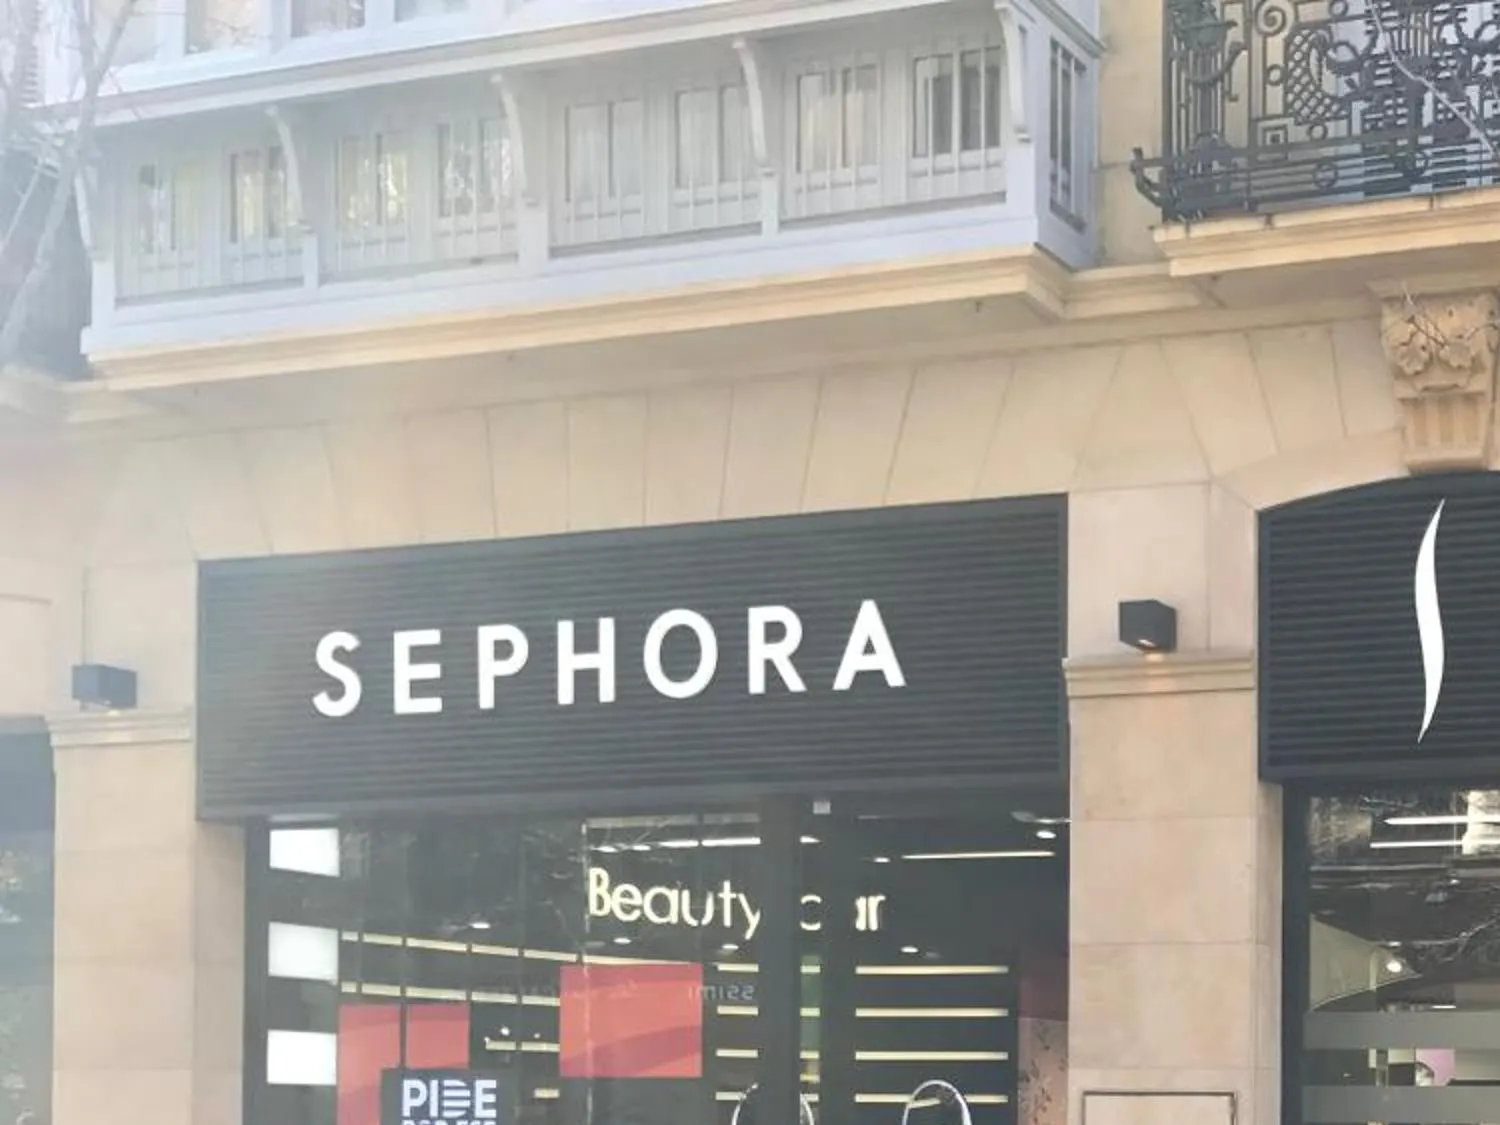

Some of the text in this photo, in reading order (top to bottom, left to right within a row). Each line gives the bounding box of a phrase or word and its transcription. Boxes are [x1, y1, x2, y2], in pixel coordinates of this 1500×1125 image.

[313, 600, 906, 717] SEPHORA
[588, 867, 761, 940] Beauty
[402, 1079, 497, 1118] PIDE
